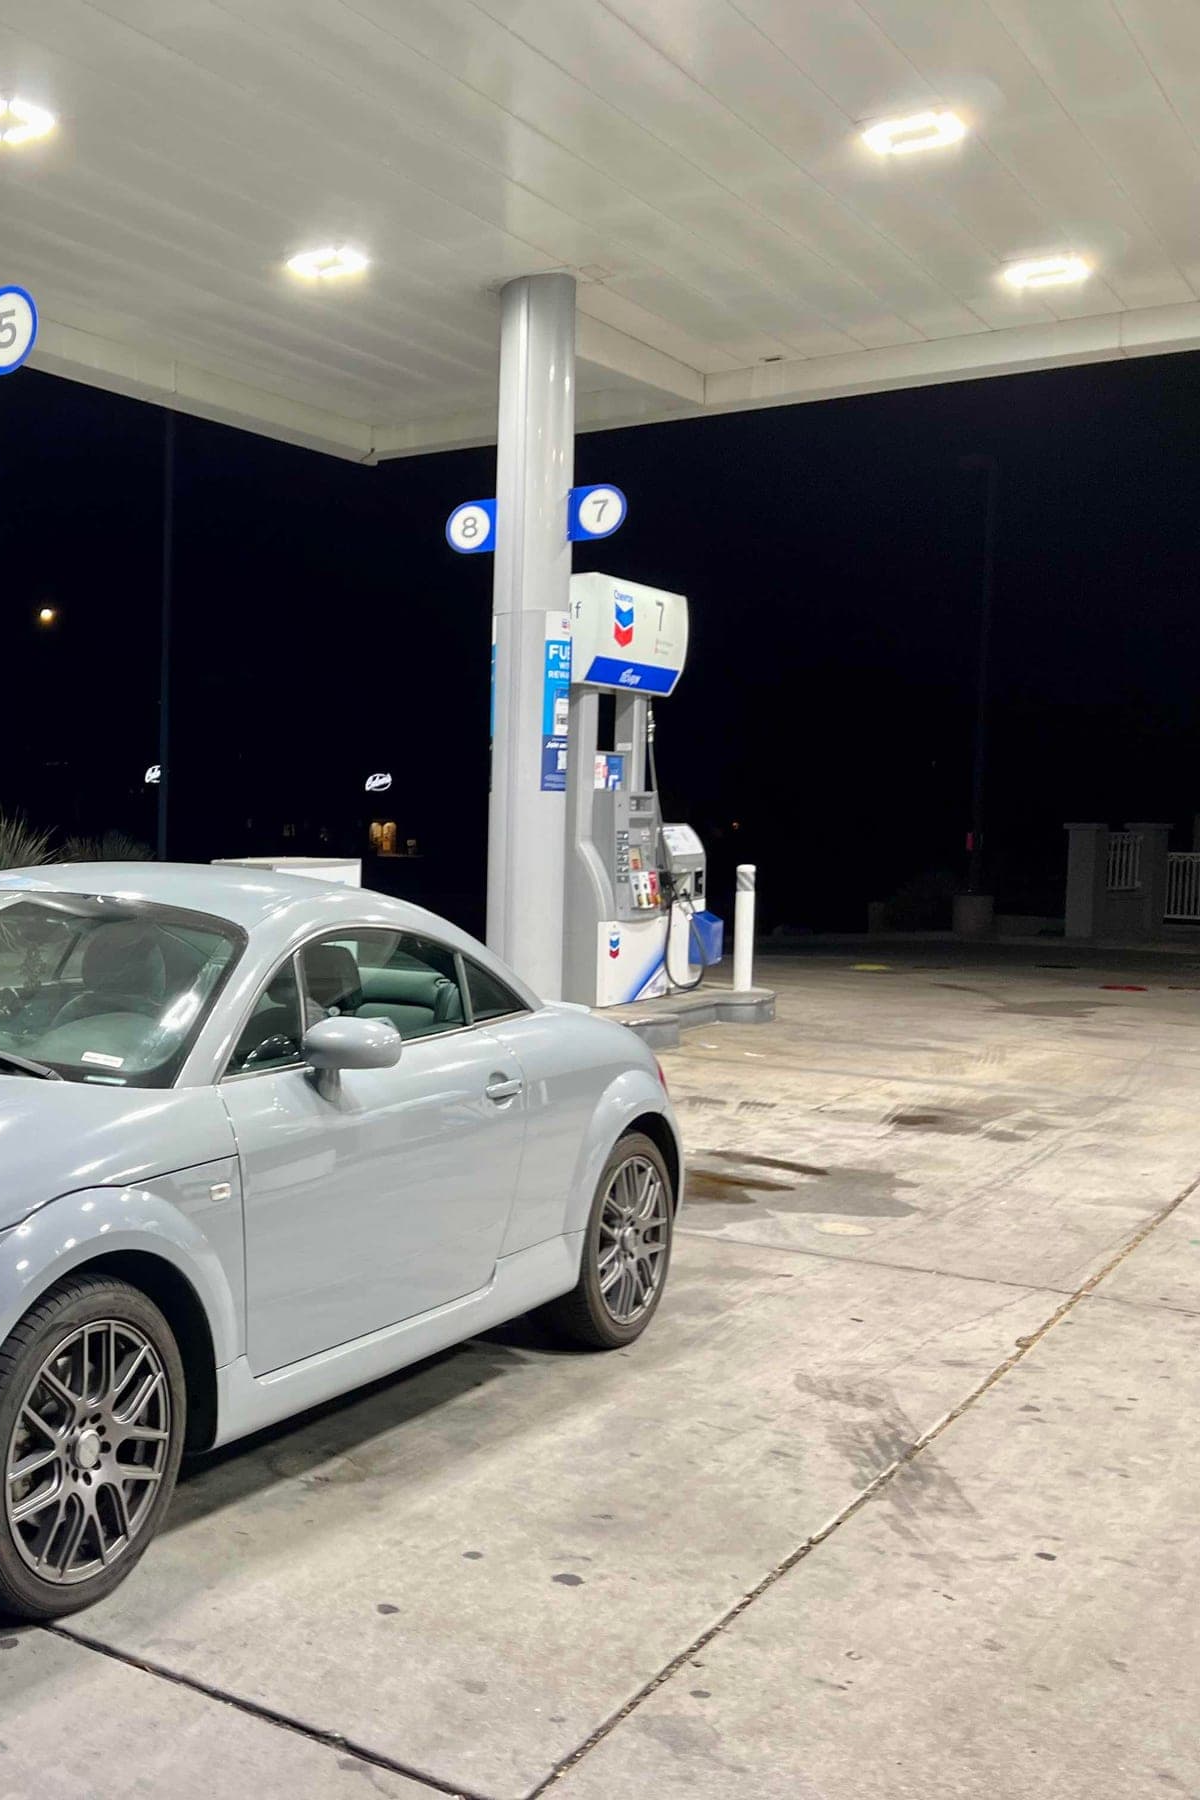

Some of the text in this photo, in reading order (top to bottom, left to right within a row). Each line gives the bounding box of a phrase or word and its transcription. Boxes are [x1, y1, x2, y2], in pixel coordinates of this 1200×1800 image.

[592, 499, 609, 523] 7
[461, 516, 478, 539] 8
[655, 600, 665, 632] 7
[548, 644, 570, 661] FU
